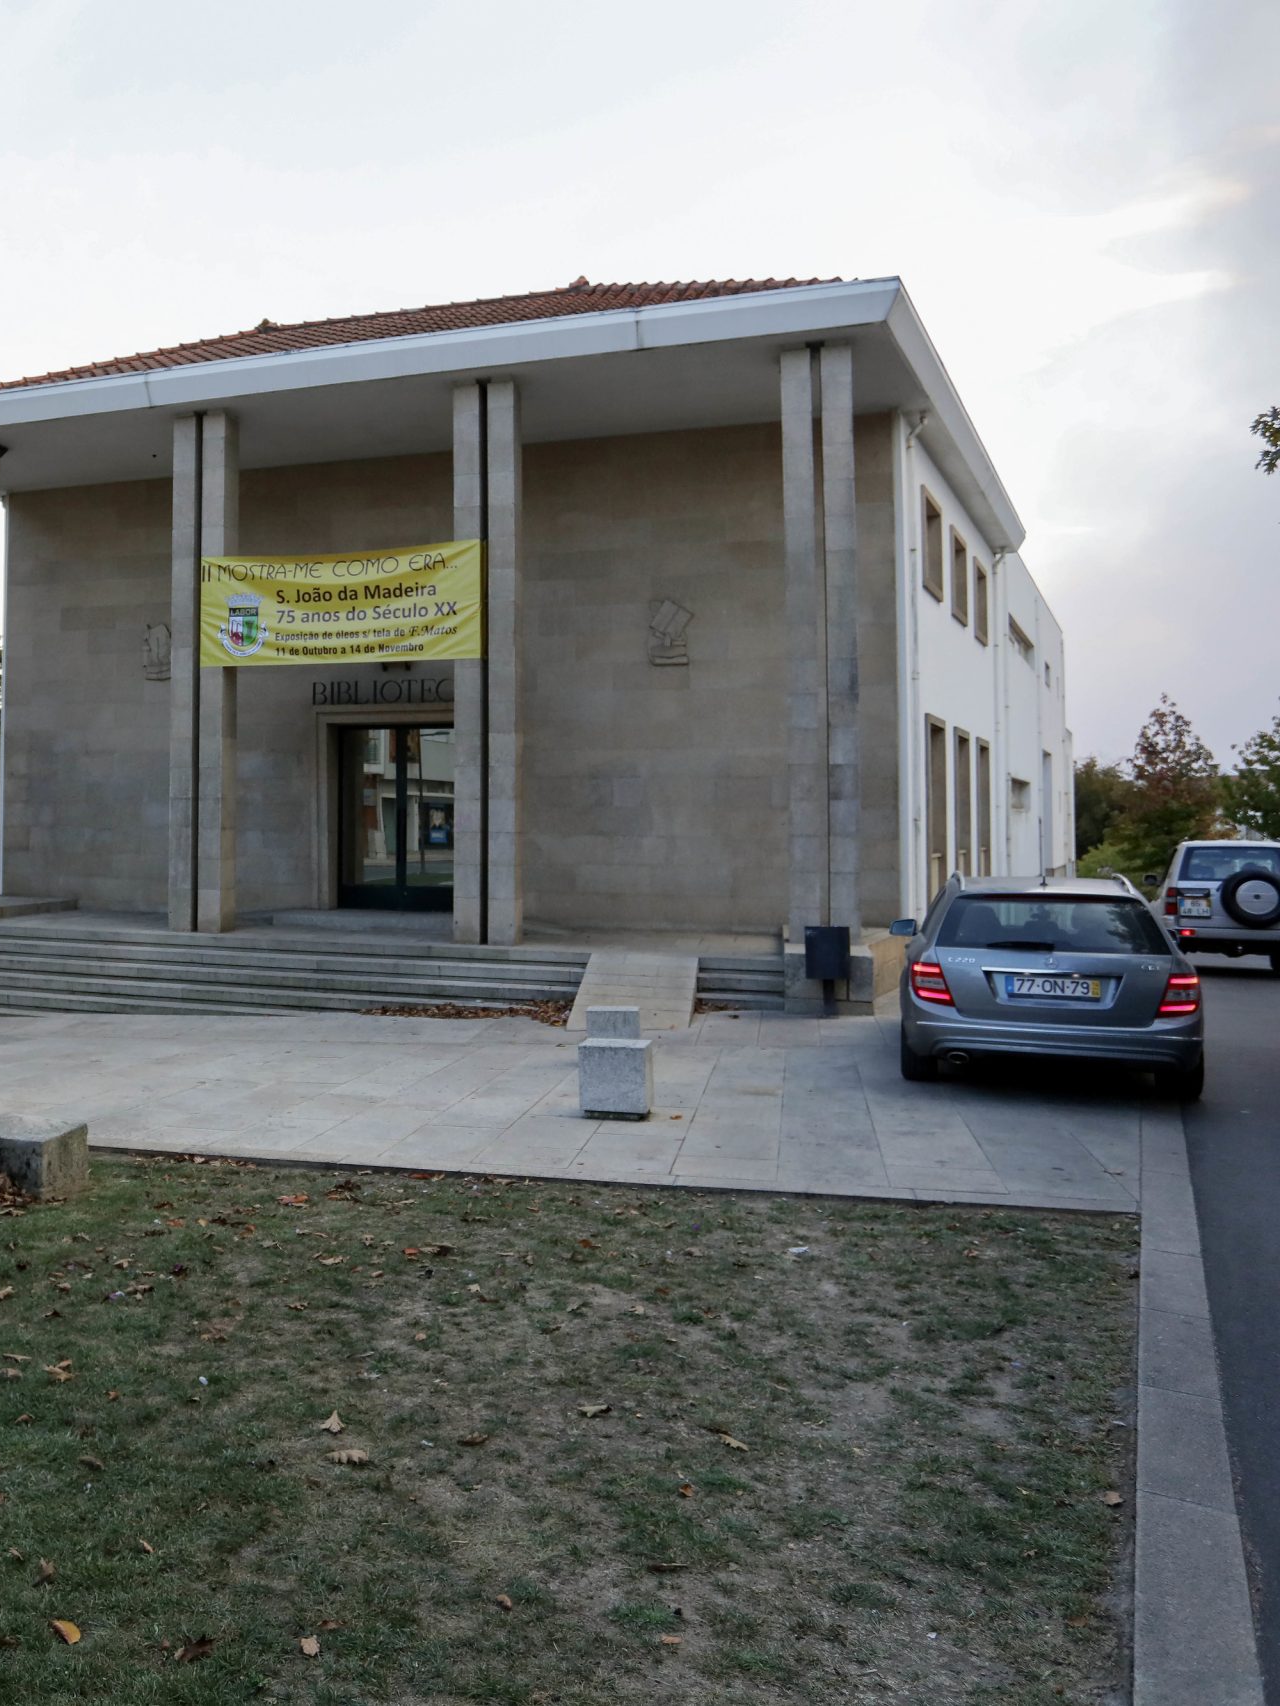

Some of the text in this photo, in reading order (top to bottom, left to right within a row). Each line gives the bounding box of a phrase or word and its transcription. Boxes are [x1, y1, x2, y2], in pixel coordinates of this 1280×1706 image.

[202, 552, 458, 582] II MOSTRA-ME COMO ERA...
[276, 582, 437, 604] S. João da Madeira
[230, 608, 258, 616] LABOR
[276, 601, 458, 624] 75 anos do Século XX
[275, 631, 319, 643] Exposição
[322, 631, 333, 640] de
[336, 630, 360, 639] óleos
[373, 627, 391, 637] tela
[394, 627, 405, 637] de
[275, 647, 286, 657] 11
[289, 647, 300, 656] de
[302, 645, 338, 656] Outubro
[350, 644, 361, 654] 14
[364, 644, 375, 654] de
[378, 643, 424, 653] Novembro
[312, 678, 455, 705] BIBLIOTEC
